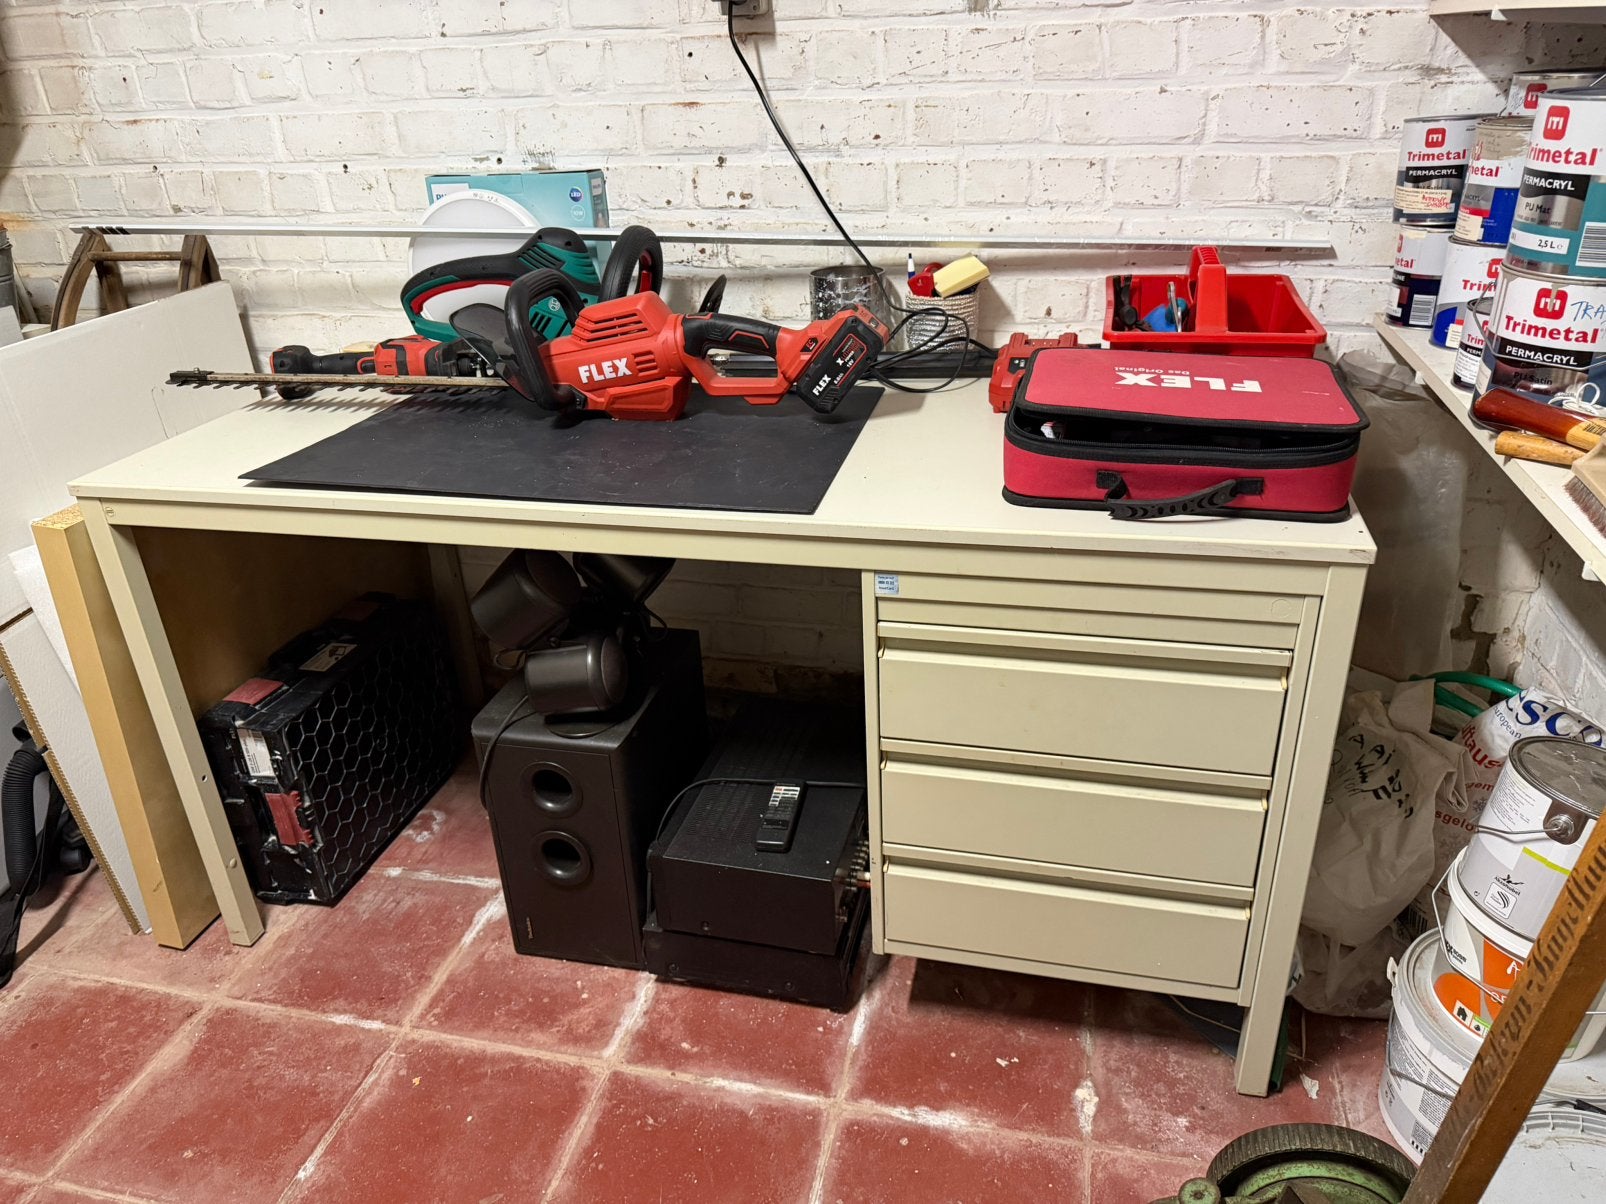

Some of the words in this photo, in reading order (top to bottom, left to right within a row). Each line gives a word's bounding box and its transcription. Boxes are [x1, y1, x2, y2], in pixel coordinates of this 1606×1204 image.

[1407, 149, 1466, 162] Trimetal
[1523, 174, 1575, 191] PERMACRYL
[1525, 201, 1535, 211] PU
[1535, 203, 1551, 213] Mat
[1538, 234, 1549, 248] 2,5
[1550, 236, 1556, 248] L
[1505, 315, 1599, 344] Trimetal
[1505, 345, 1577, 365] PERMACRYL
[578, 357, 632, 383] FLEX
[1114, 366, 1164, 374] Original
[812, 374, 831, 396] FLEX
[1115, 371, 1262, 393] FLEX
[1529, 373, 1553, 386] Satin
